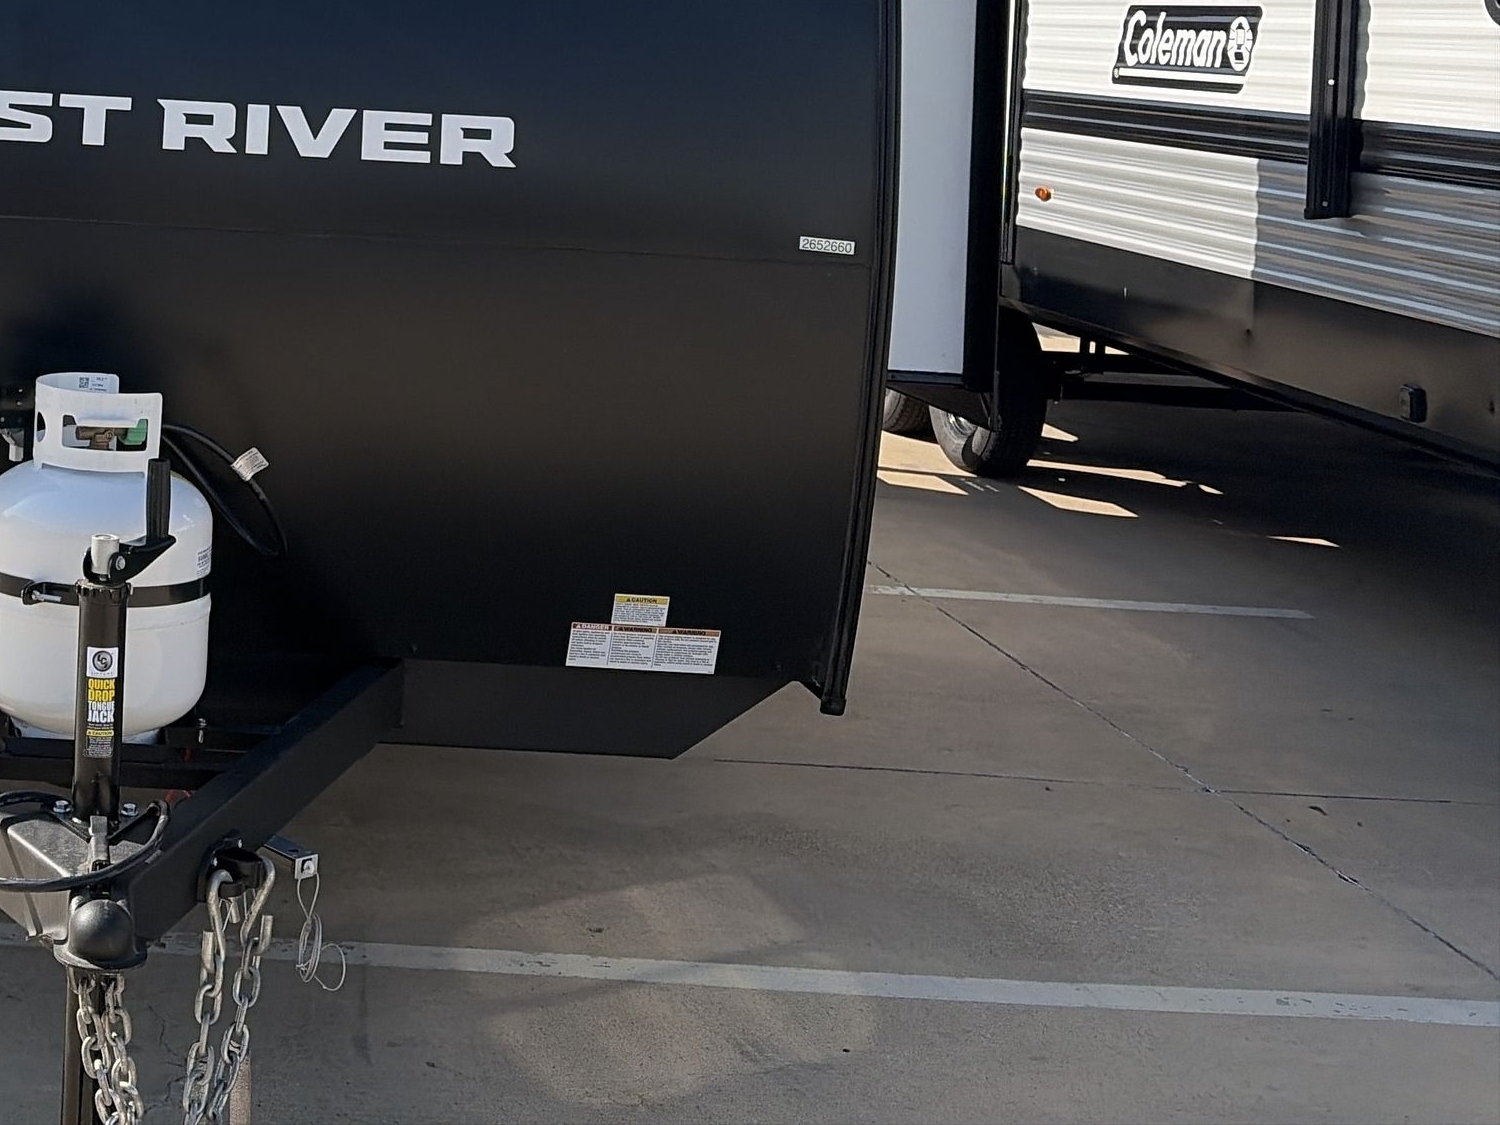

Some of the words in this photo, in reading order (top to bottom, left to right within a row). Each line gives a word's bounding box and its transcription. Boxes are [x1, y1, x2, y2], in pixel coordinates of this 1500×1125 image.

[1123, 9, 1227, 68] Coleman
[156, 98, 518, 169] RIVER
[801, 238, 853, 254] 2652660
[631, 596, 658, 604] CAUTION
[581, 623, 610, 631] DANGER
[88, 678, 116, 690] QUICK
[88, 689, 116, 702] DROP
[87, 700, 116, 711] TONGUE
[86, 710, 115, 724] JACK
